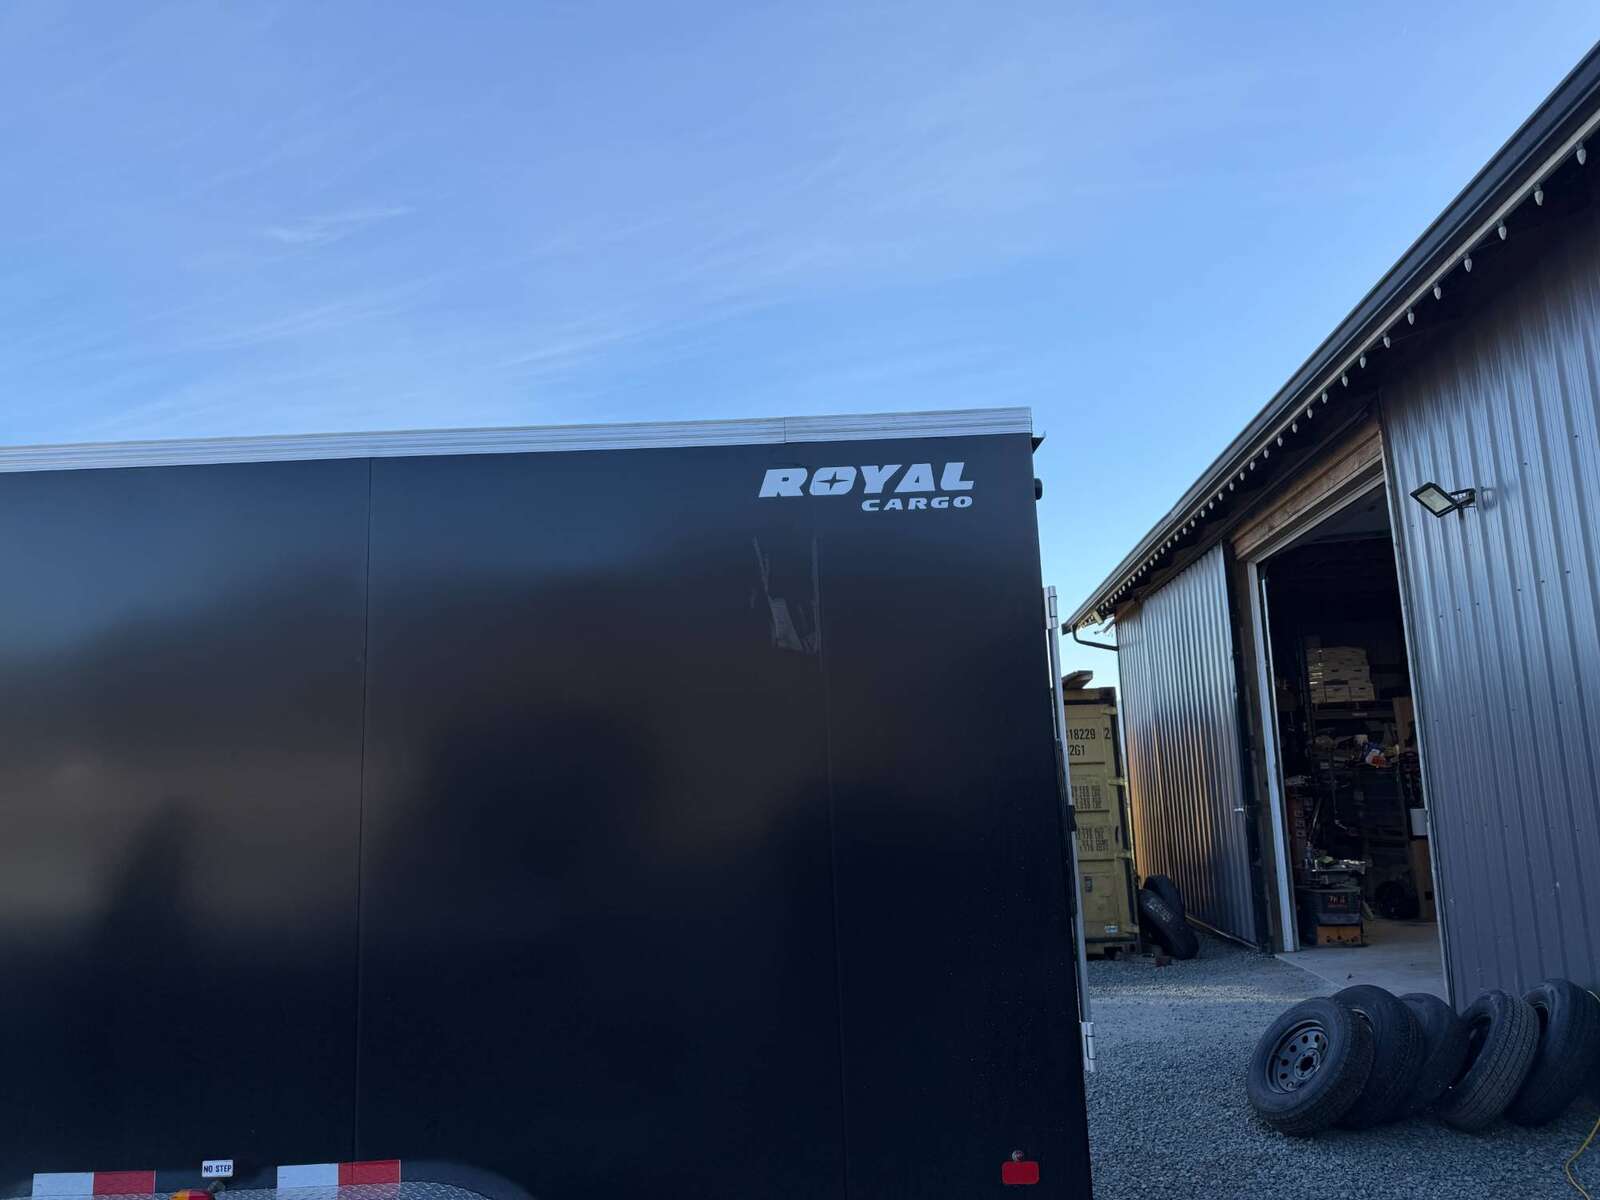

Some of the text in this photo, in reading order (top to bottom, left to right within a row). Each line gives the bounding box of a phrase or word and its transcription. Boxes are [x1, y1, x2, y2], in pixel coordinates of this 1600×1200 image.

[758, 462, 975, 498] ROYAL
[861, 496, 973, 512] CARGO
[1104, 727, 1111, 740] 2
[1068, 744, 1085, 756] 2G1
[204, 1165, 231, 1173] NO STEP
